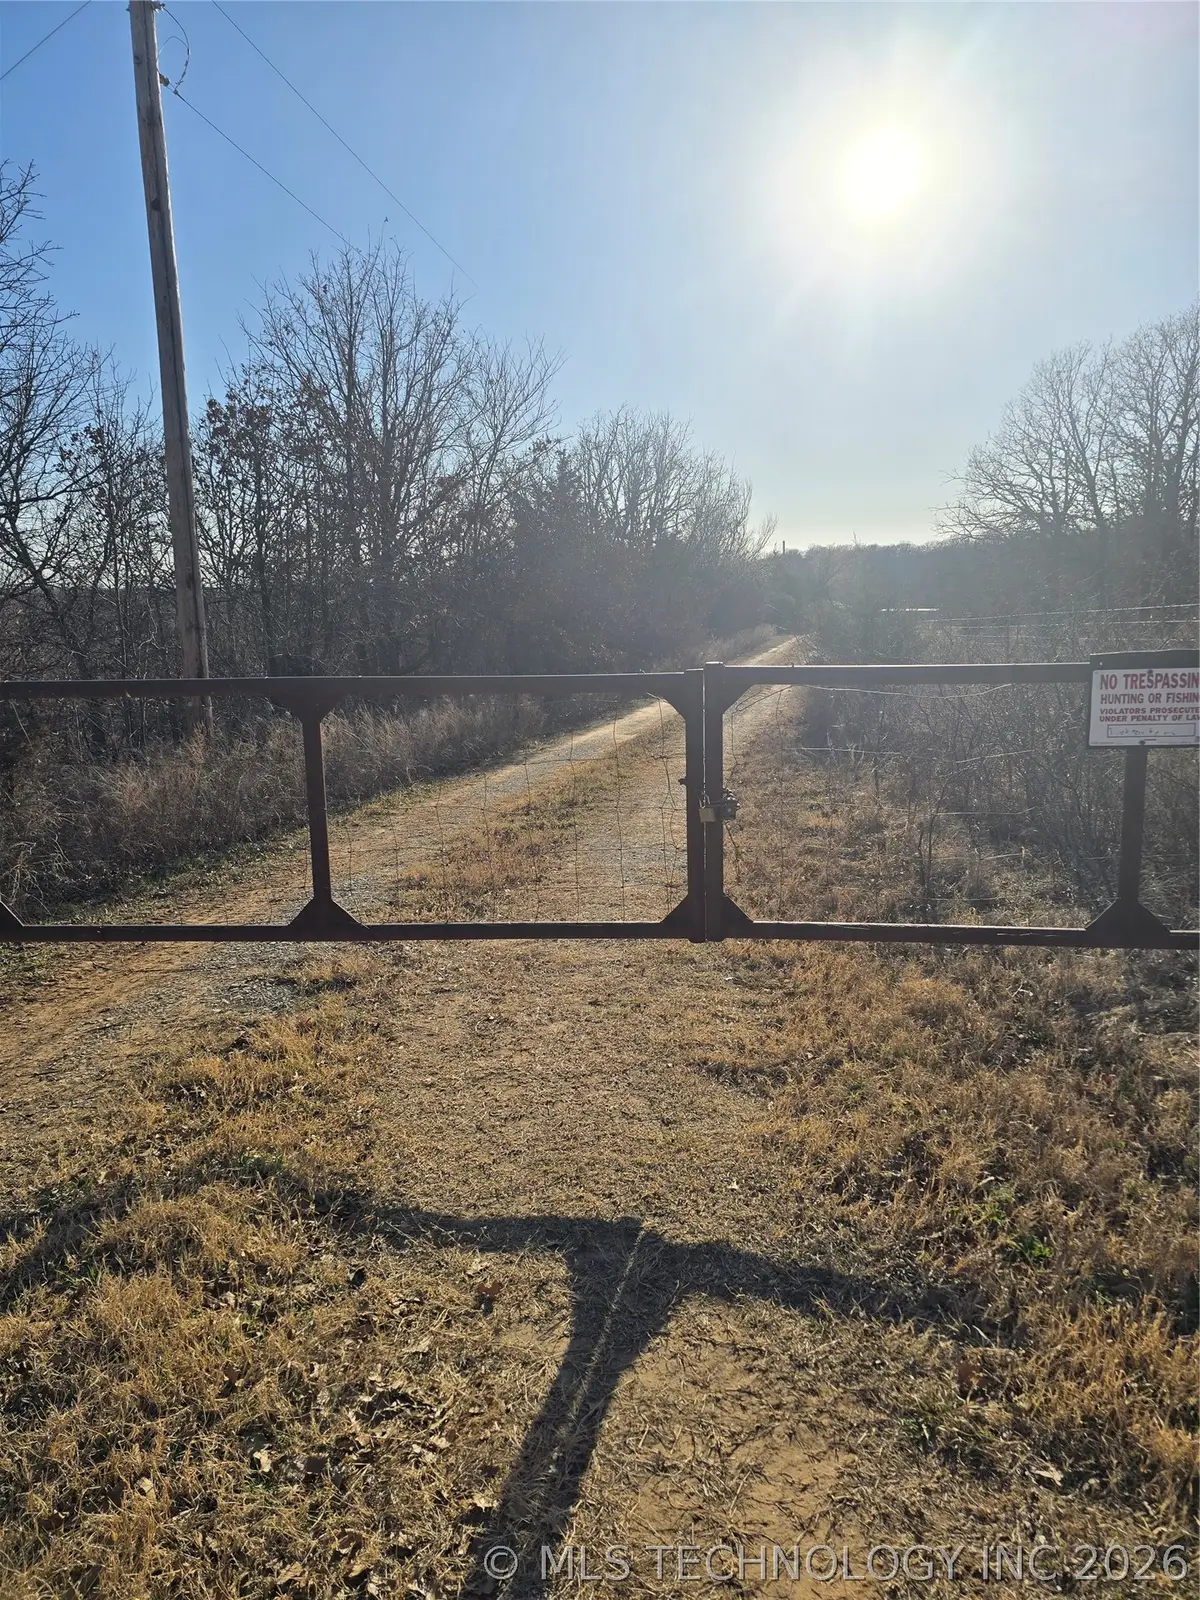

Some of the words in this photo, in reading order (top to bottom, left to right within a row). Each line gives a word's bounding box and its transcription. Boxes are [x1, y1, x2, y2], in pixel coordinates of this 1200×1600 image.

[1100, 674, 1117, 690] NO
[1100, 693, 1144, 704] HUNTING
[1148, 692, 1161, 703] OR
[1100, 707, 1146, 715] VIOLATORS
[1131, 714, 1168, 722] PENALTY
